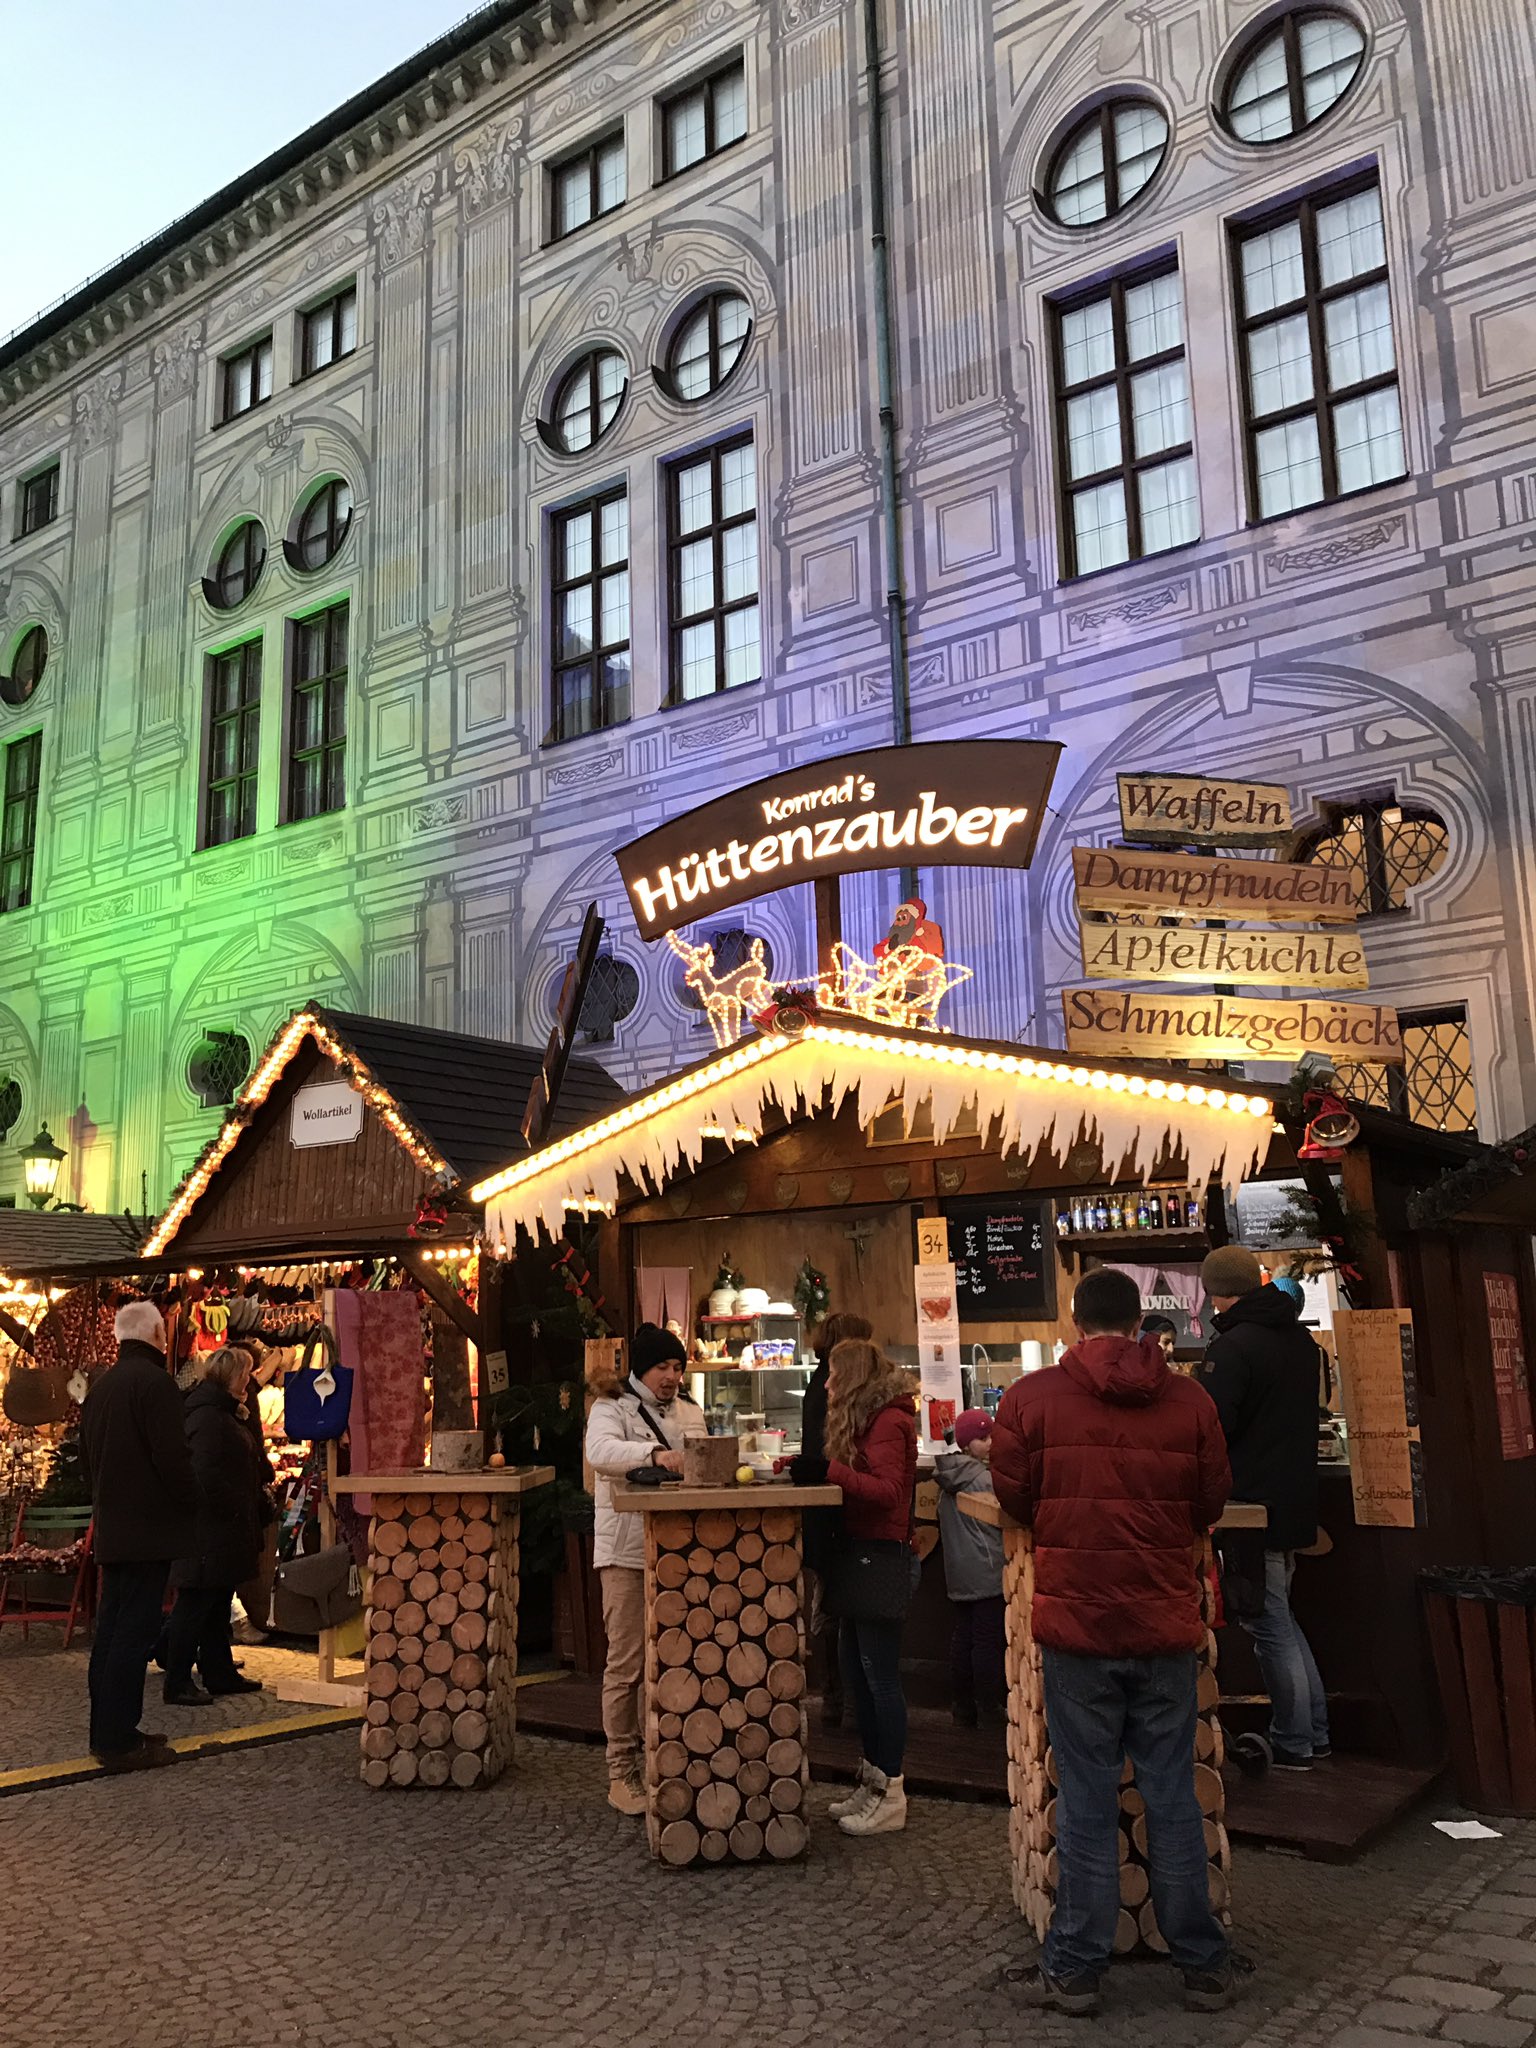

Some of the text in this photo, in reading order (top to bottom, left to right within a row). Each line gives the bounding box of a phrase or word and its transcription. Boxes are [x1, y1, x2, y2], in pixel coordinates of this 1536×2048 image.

[1124, 783, 1285, 832] Waffeln
[633, 791, 1028, 922] Hüttenzauber
[1079, 853, 1354, 908] Dampfnudeln
[1088, 929, 1362, 975] Apfelküchle
[1069, 989, 1399, 1051] Schmalzgebäck
[303, 1104, 352, 1120] Wollartikel
[923, 1234, 944, 1254] 34
[491, 1367, 505, 1385] 35
